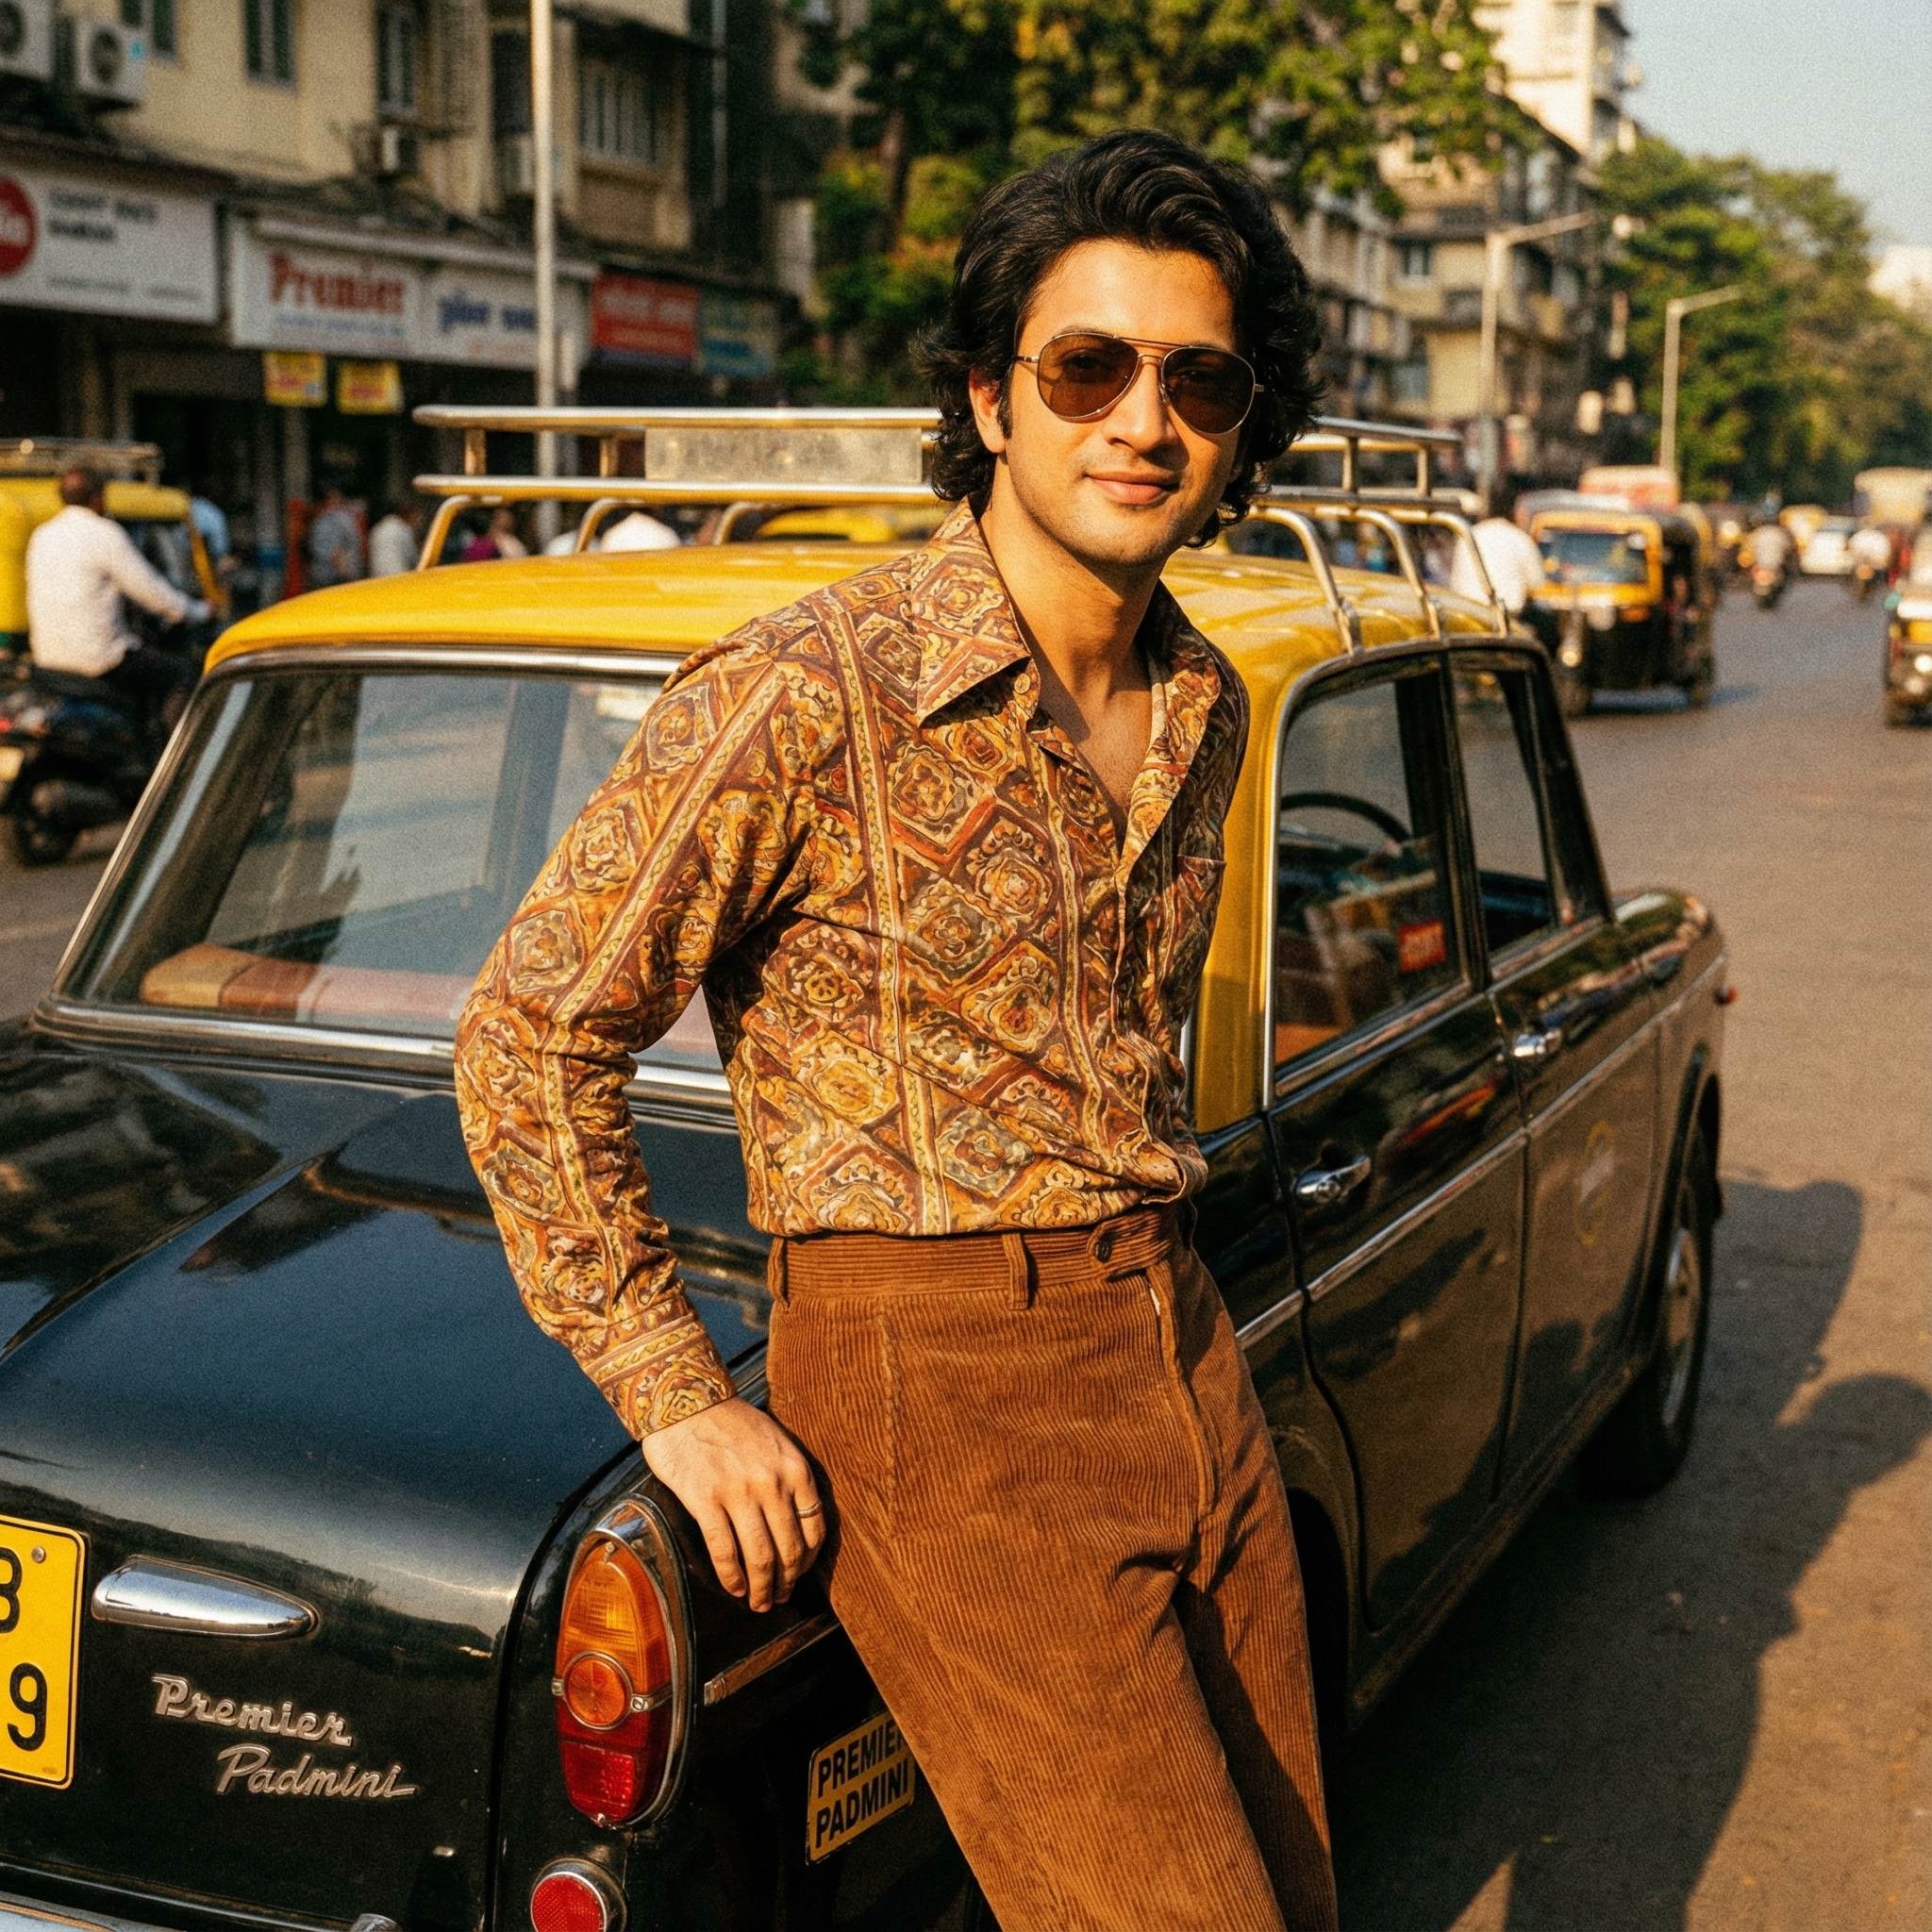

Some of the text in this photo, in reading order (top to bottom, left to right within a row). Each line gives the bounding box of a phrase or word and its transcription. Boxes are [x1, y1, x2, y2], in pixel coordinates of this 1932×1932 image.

[8, 1662, 48, 1752] 9
[152, 1674, 353, 1746] Premier
[217, 1743, 416, 1798] Padmini
[815, 1757, 908, 1849] PADMINI
